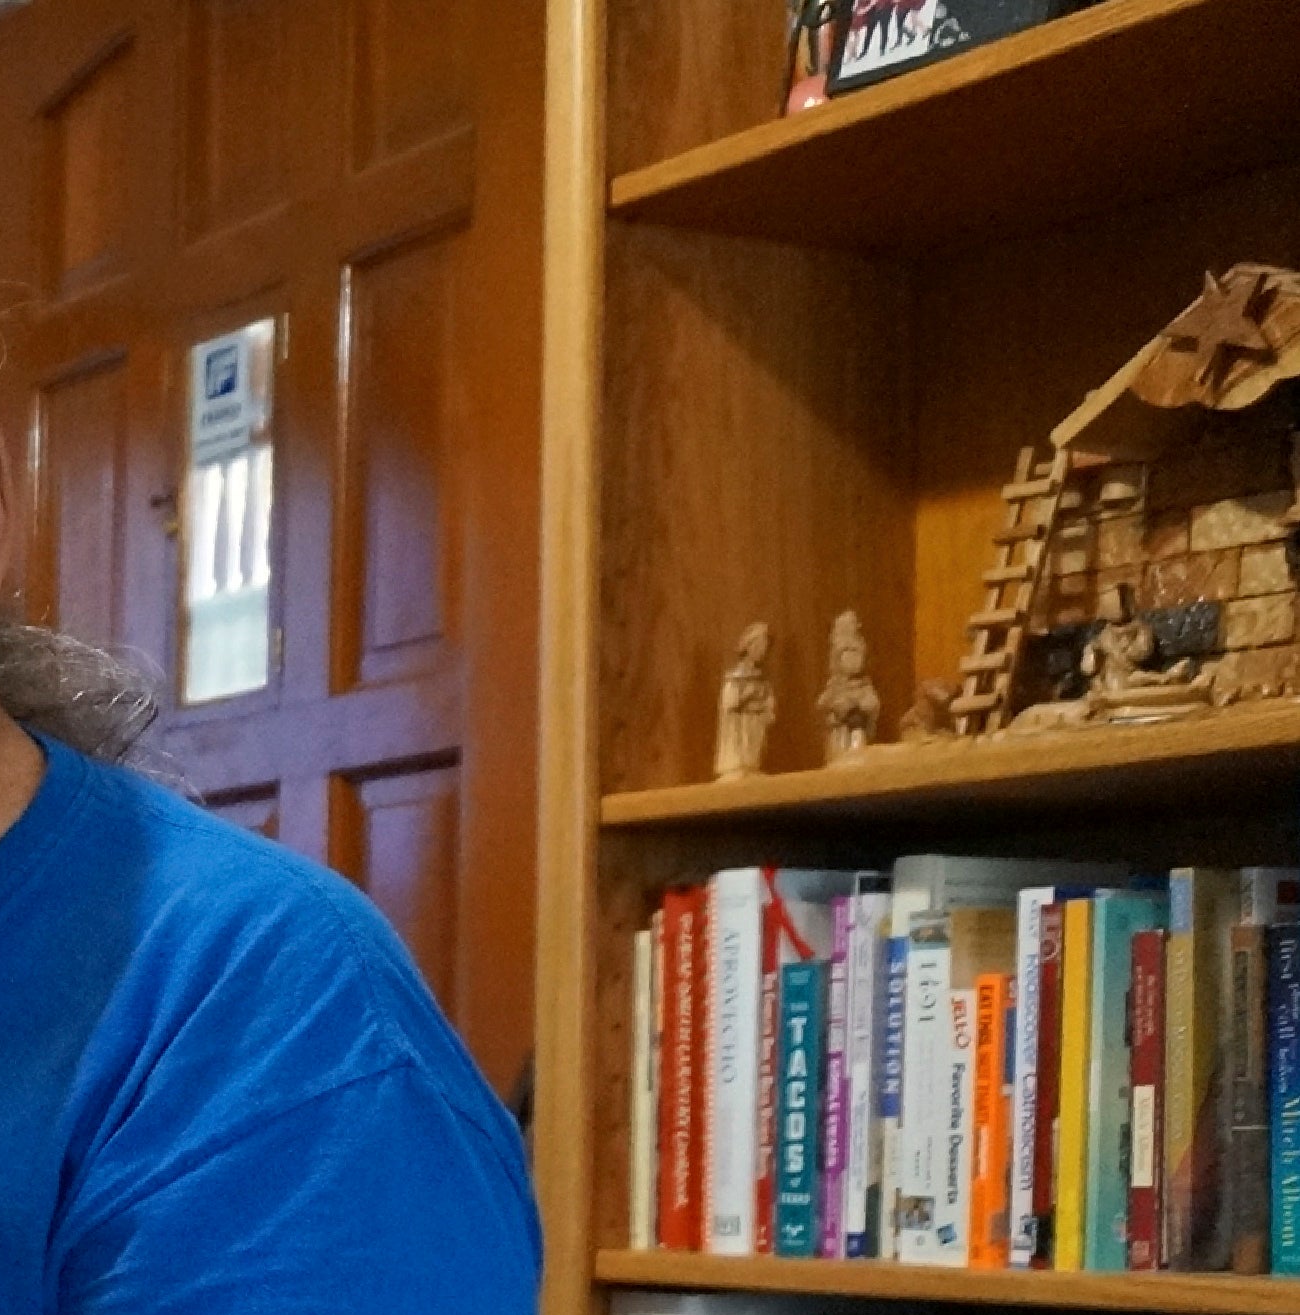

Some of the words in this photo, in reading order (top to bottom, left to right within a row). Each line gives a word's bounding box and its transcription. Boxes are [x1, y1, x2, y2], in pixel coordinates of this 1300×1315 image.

[883, 960, 905, 1095] SOLUTION
[979, 984, 994, 1012] EAT
[1022, 953, 1039, 1068] Rediscover
[783, 1016, 808, 1173] TACOS
[951, 1063, 966, 1129] Favorite
[1019, 1072, 1038, 1191] Catholicism
[948, 1134, 964, 1204] Desserts
